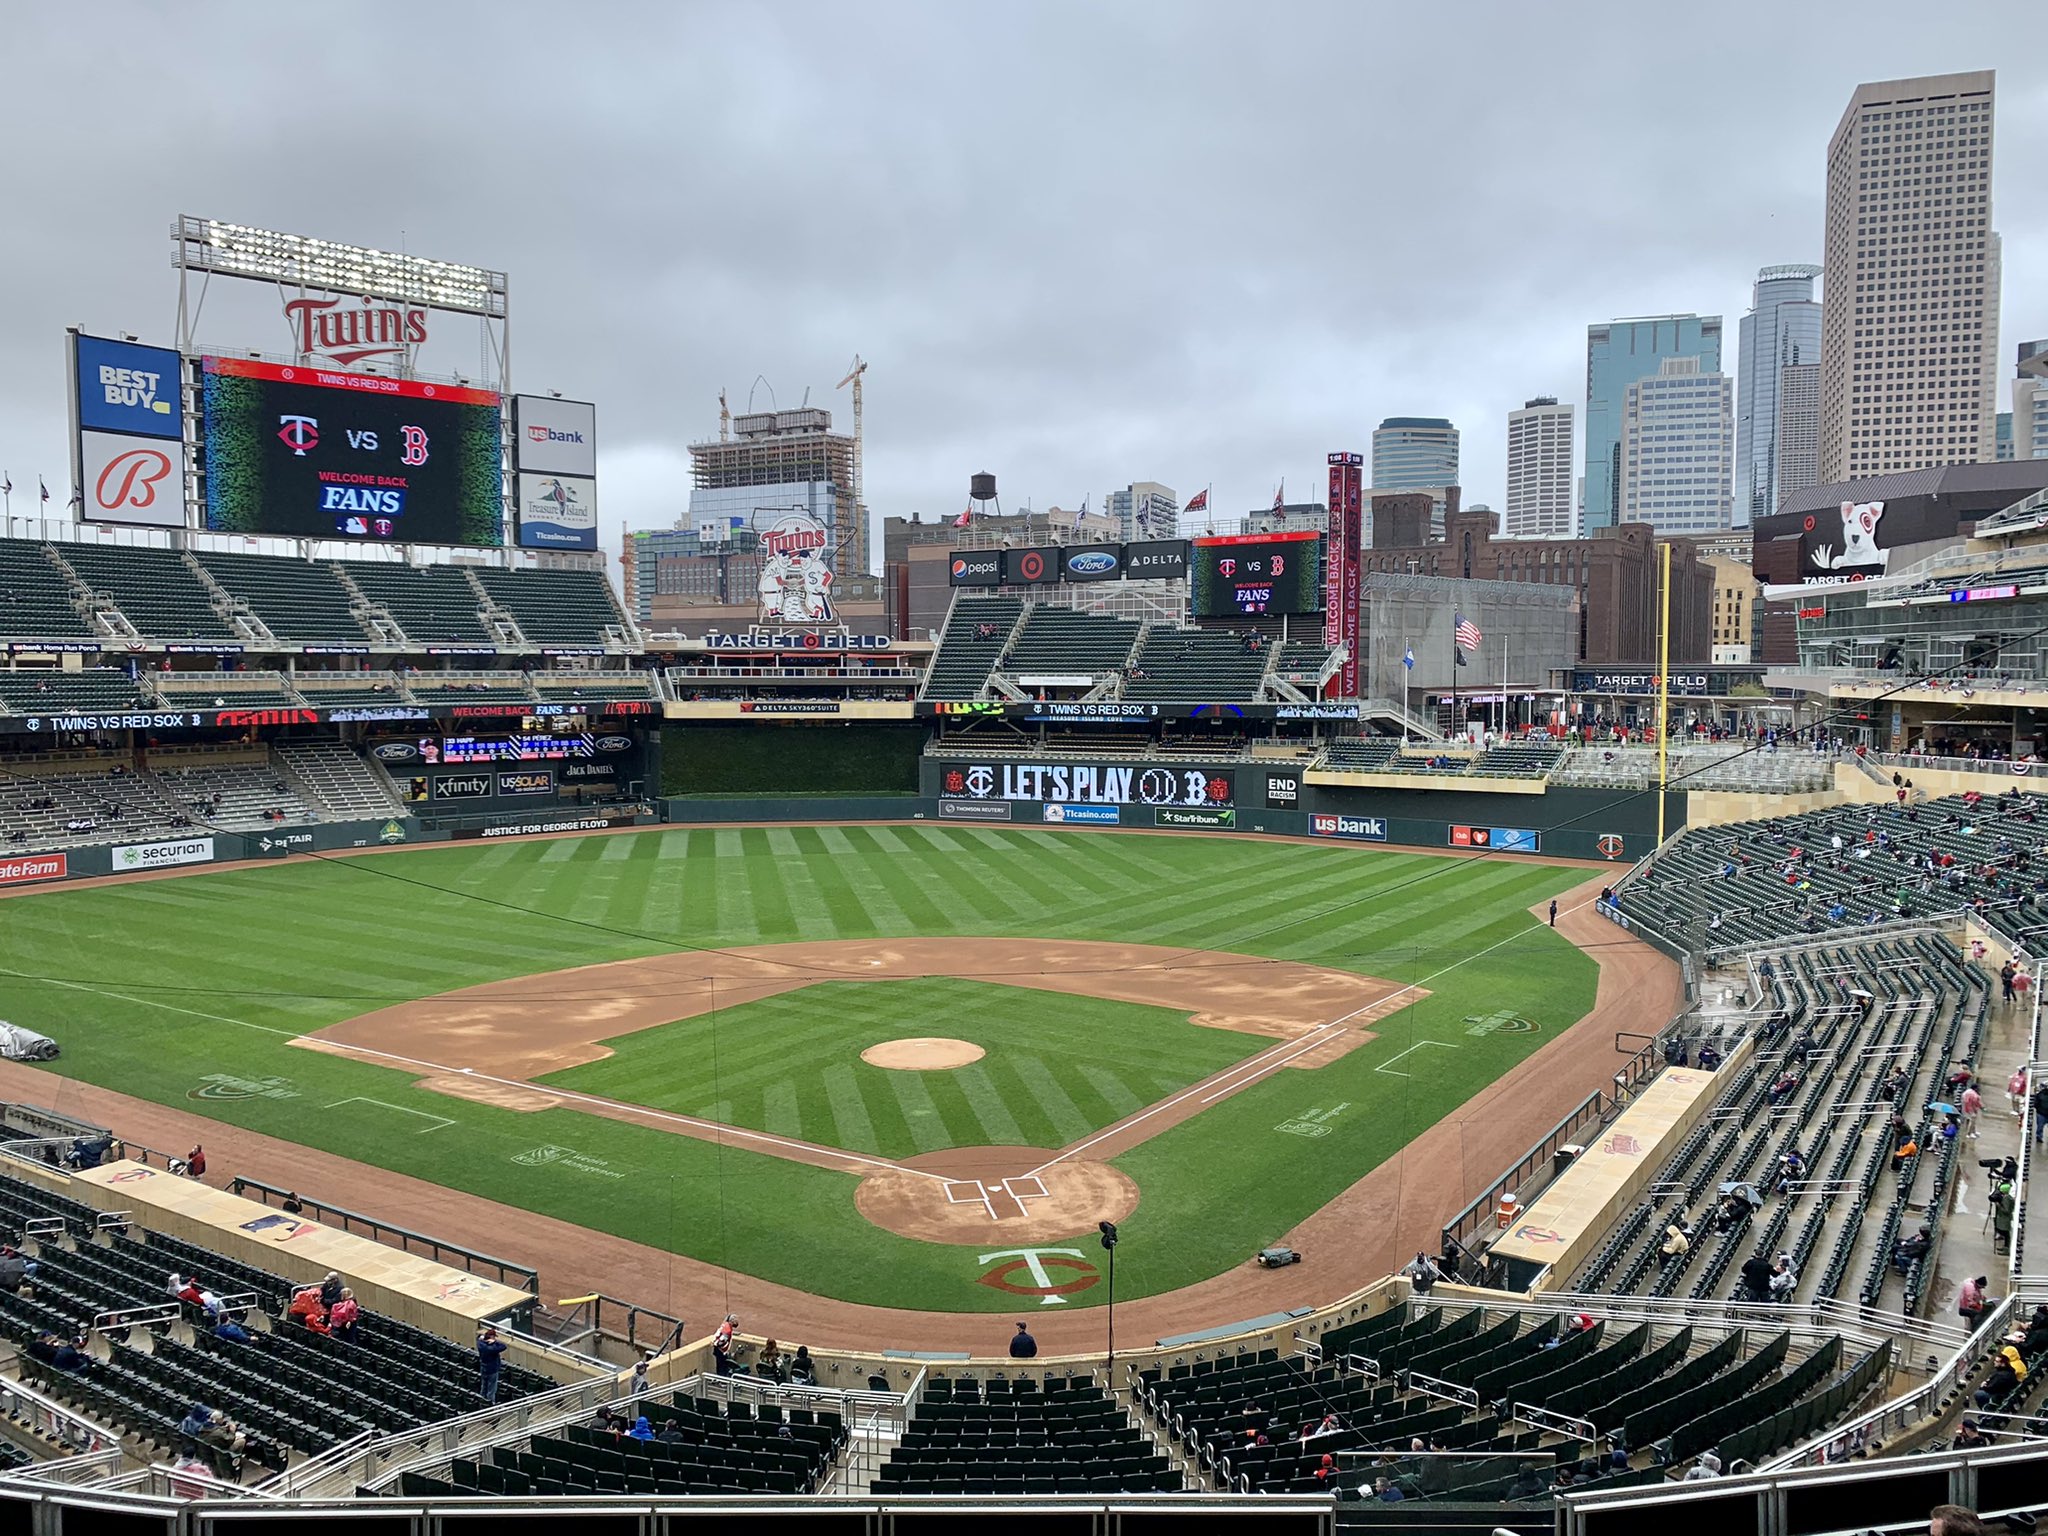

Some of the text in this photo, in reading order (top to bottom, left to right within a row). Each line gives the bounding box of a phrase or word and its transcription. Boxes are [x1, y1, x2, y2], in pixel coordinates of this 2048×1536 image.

[283, 295, 427, 357] Twins
[99, 365, 160, 391] BEST
[316, 373, 400, 392] TWINS VS RED SOX
[105, 385, 156, 409] BUY
[346, 429, 378, 450] VS
[400, 425, 430, 466] B
[319, 471, 375, 485] WELCOME
[322, 486, 401, 513] FANS
[527, 501, 588, 517] Treasure Island
[761, 527, 826, 557] Twins
[968, 560, 998, 575] pepsi
[1078, 555, 1107, 570] Ford
[1143, 555, 1182, 566] DELTA
[1247, 561, 1261, 571] VS
[1803, 576, 1850, 585] TARGET
[1236, 589, 1270, 601] FANS
[1328, 588, 1339, 645] WELCOME
[707, 634, 891, 648] TARGET FIELD
[1346, 613, 1355, 694] WELCOME
[1595, 675, 1707, 686] TARGET FIELD
[453, 705, 563, 717] WELCOME BACK FANS
[1049, 705, 1081, 715] TWINS
[1083, 706, 1097, 714] VS
[1098, 706, 1120, 715] RED
[1121, 706, 1144, 715] SOX
[51, 717, 97, 730] TWINS
[100, 717, 120, 729] VS
[122, 716, 151, 728] RED
[154, 714, 183, 727] SOX
[384, 745, 407, 757] Ford
[604, 739, 624, 749] Ford
[567, 765, 585, 776] JACK
[437, 777, 489, 796] xfinity
[1004, 765, 1069, 801] LET'S
[1073, 766, 1133, 803] PLAY
[1268, 779, 1296, 791] END
[481, 820, 608, 837] JUSTICE FOR GEORGE FLOYD
[143, 843, 204, 859] securian
